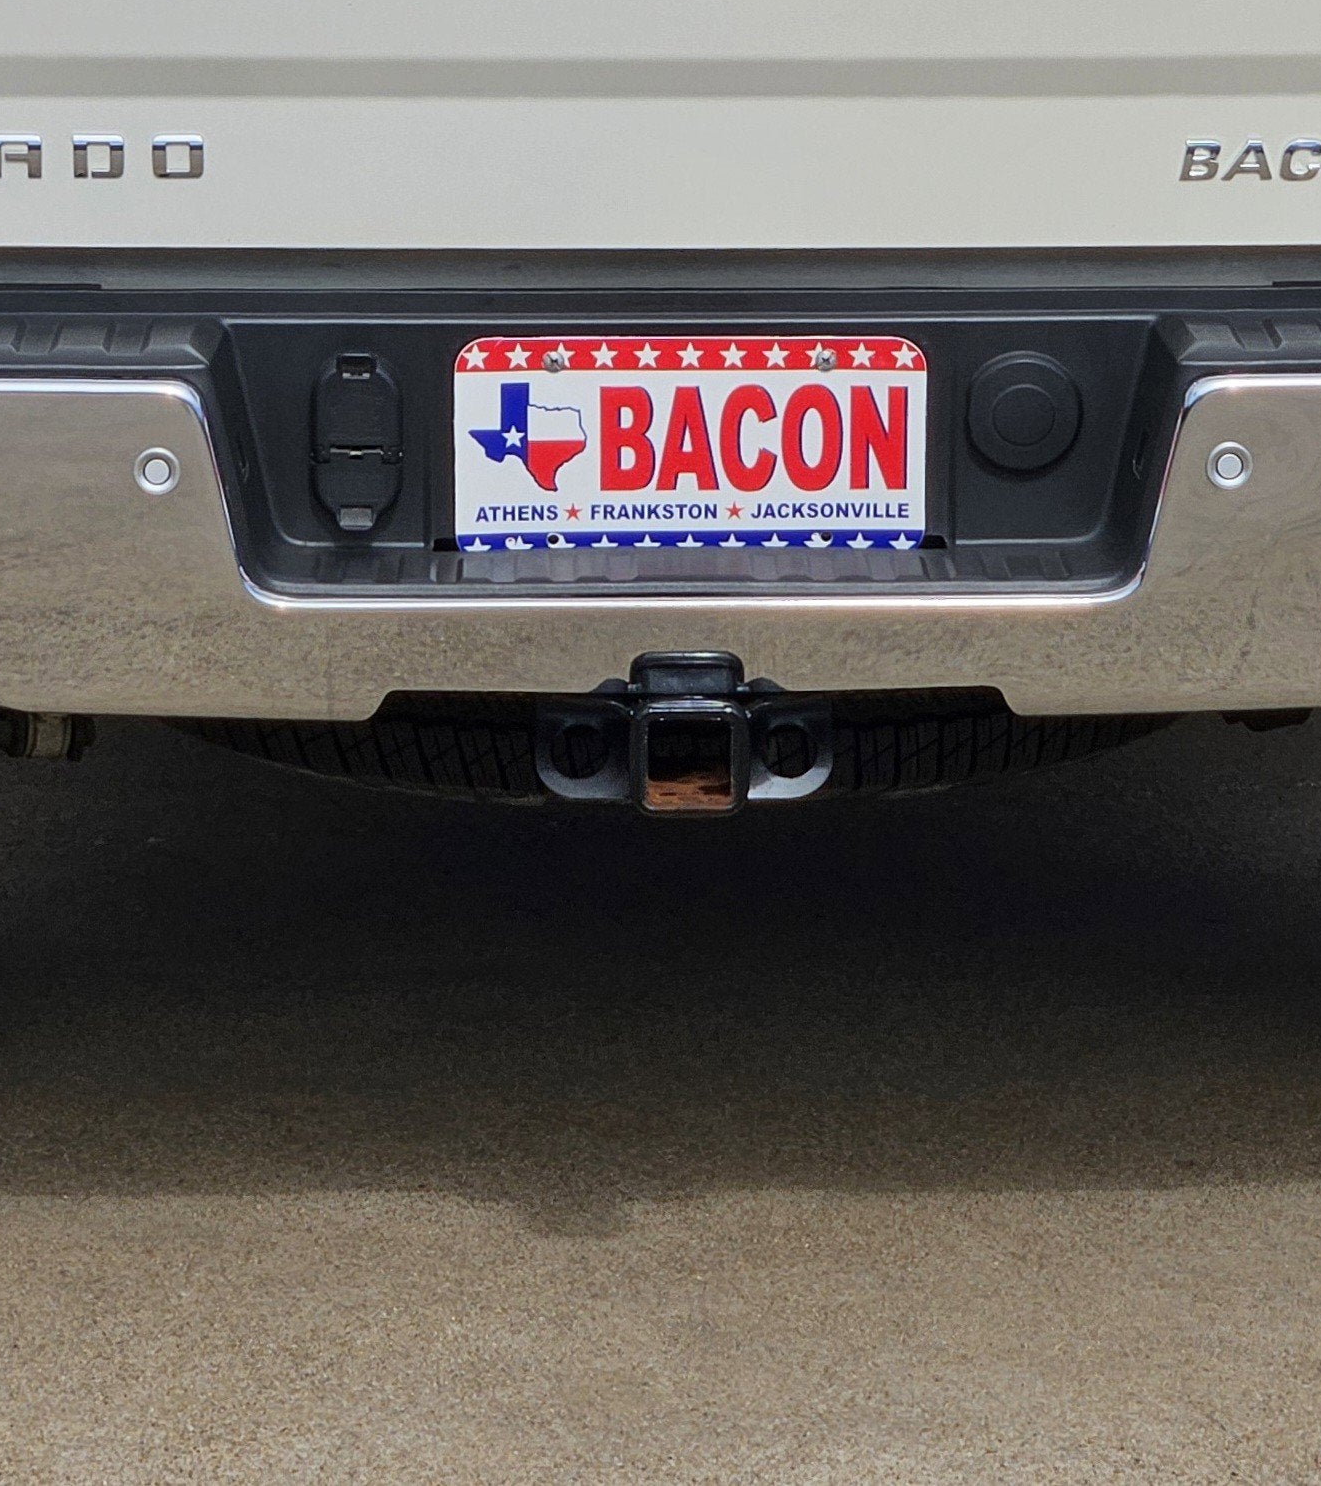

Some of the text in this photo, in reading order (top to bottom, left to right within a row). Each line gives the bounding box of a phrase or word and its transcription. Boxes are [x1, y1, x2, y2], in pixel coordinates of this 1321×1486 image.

[599, 383, 909, 491] BACON
[475, 502, 909, 522] ATHENS FRANKSTON JACKSONVILLE
